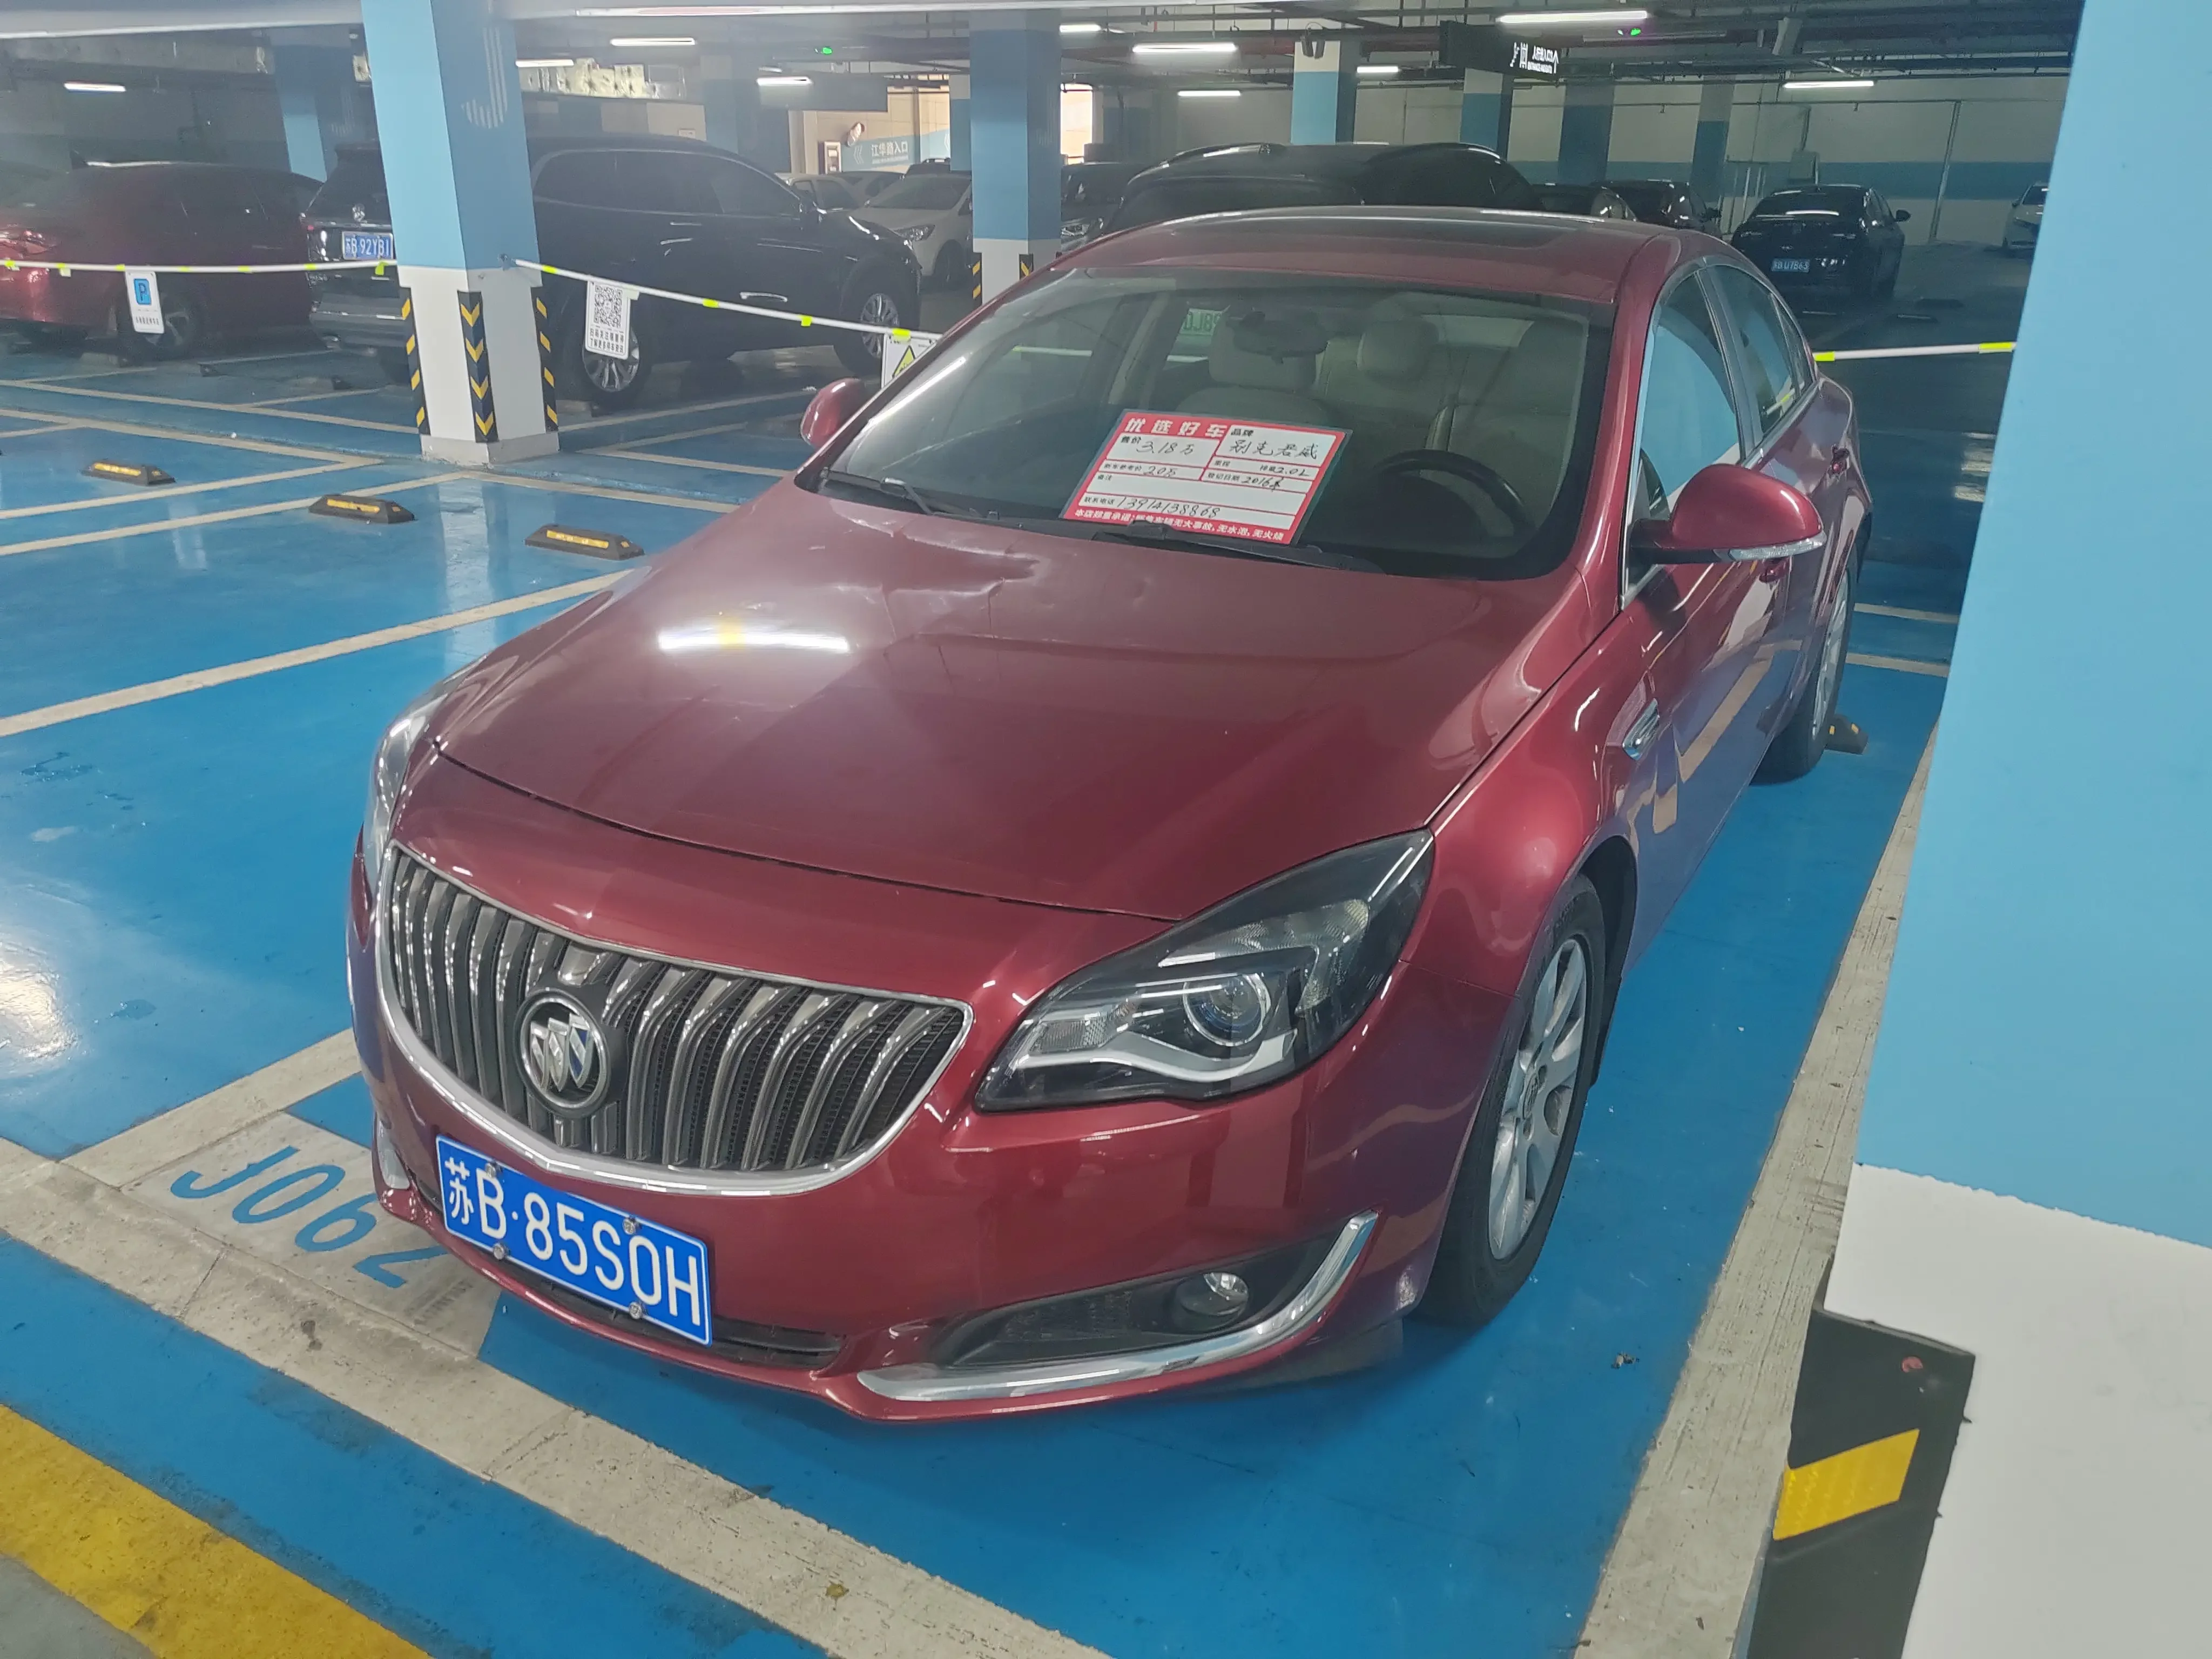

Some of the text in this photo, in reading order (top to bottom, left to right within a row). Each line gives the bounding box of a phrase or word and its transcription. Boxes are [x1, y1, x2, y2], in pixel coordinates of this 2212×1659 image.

[871, 140, 908, 157] 江华路入口
[1124, 417, 1228, 438] 优选好车
[1231, 428, 1253, 437] 品牌
[1121, 436, 1195, 455] 售价 3.18万
[1229, 439, 1318, 460] 别克君威
[1143, 466, 1177, 477] 20万
[1208, 473, 1240, 481] 登记日期
[1275, 466, 1309, 477] 2.0L
[1083, 496, 1115, 505] 联系电话
